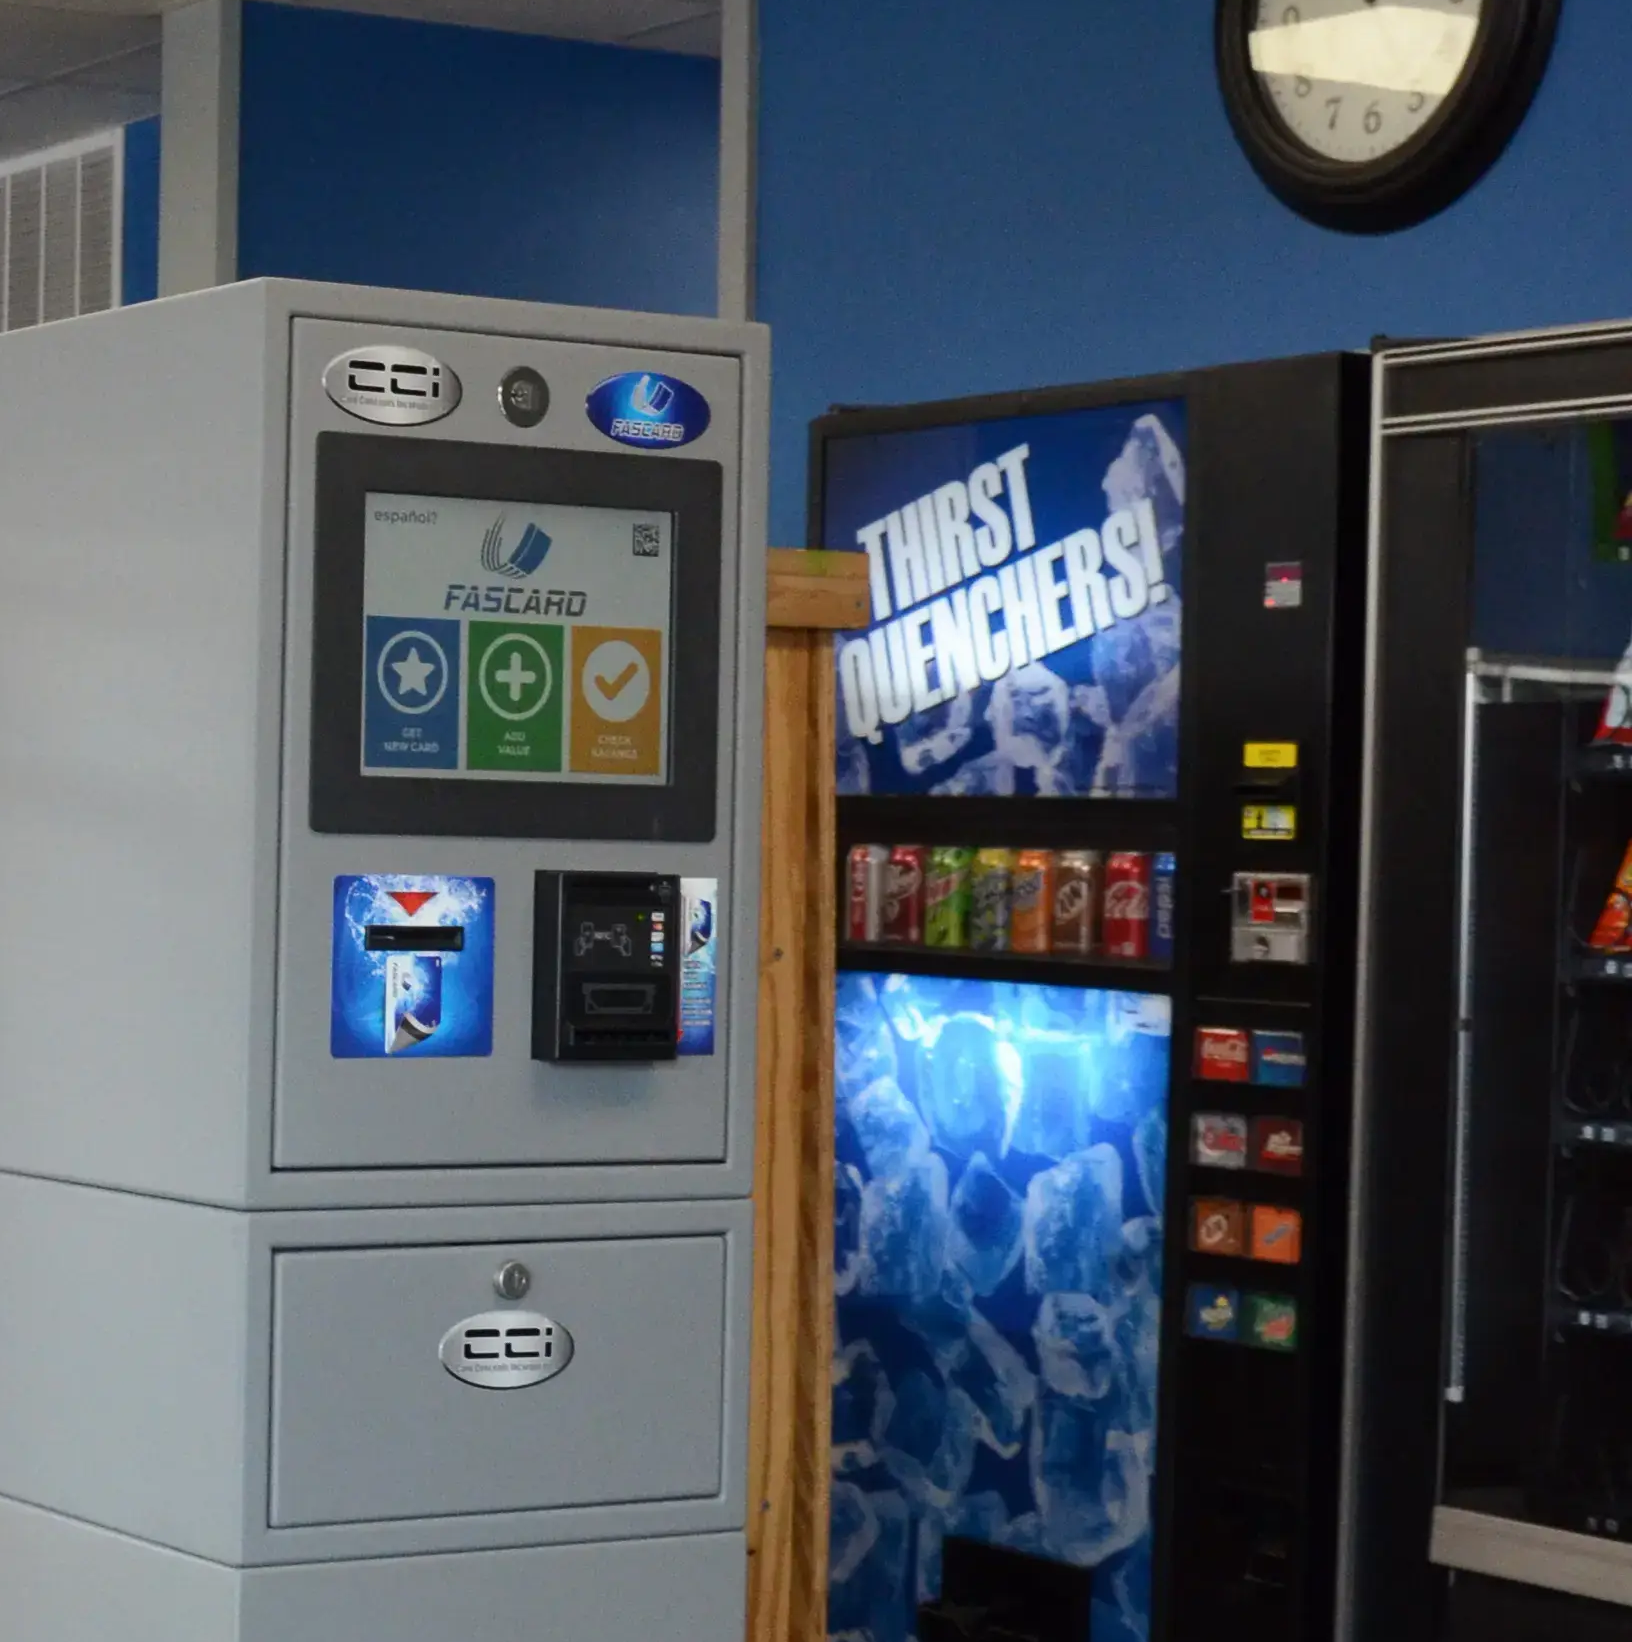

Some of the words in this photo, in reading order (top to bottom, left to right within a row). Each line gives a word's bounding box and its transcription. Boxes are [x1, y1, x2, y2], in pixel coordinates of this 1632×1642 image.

[1408, 81, 1426, 114] 5
[1325, 98, 1342, 130] 7
[1364, 103, 1381, 135] 6
[610, 418, 685, 442] FASCARD
[374, 509, 438, 525] español?
[856, 442, 1036, 622] THIRST
[443, 584, 588, 617] FASCARD
[838, 497, 1170, 745] QUENCHERS!
[411, 742, 440, 753] CARD
